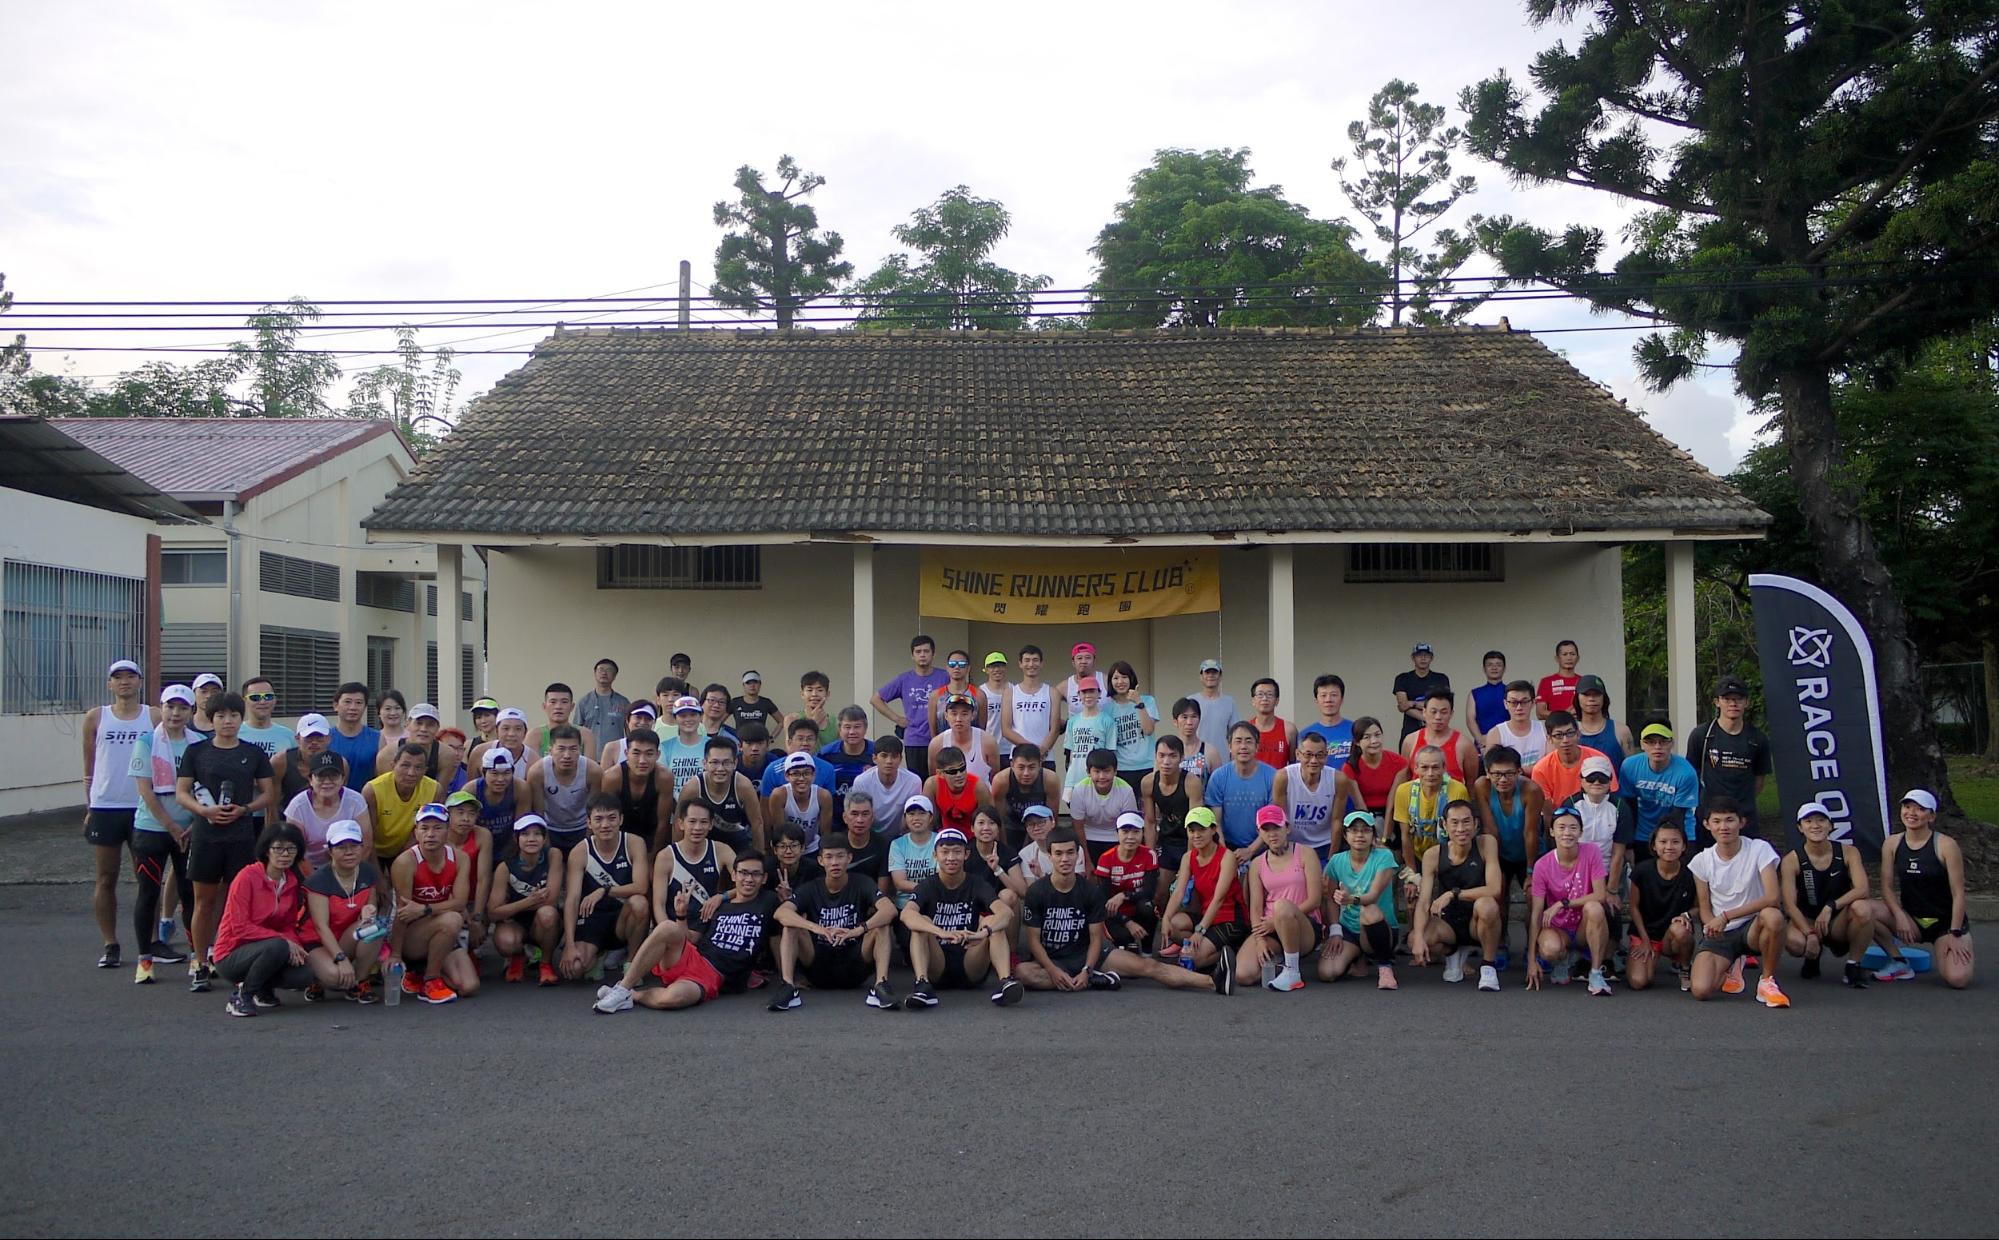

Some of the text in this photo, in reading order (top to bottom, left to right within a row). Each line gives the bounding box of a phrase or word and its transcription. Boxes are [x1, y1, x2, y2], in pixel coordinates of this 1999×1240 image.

[942, 566, 1184, 598] SHINE RUNNERS CLUB
[672, 758, 699, 767] SHINE
[1796, 676, 1854, 845] RACE ON
[905, 859, 930, 868] SHINE
[820, 904, 849, 919] SHINE
[936, 902, 963, 913] SHINE
[1045, 907, 1075, 919] SHINE
[717, 913, 750, 924] SHINE
[933, 913, 972, 925] RUNNER
[716, 922, 761, 937] RUNNER
[1043, 919, 1086, 931] RUNNER
